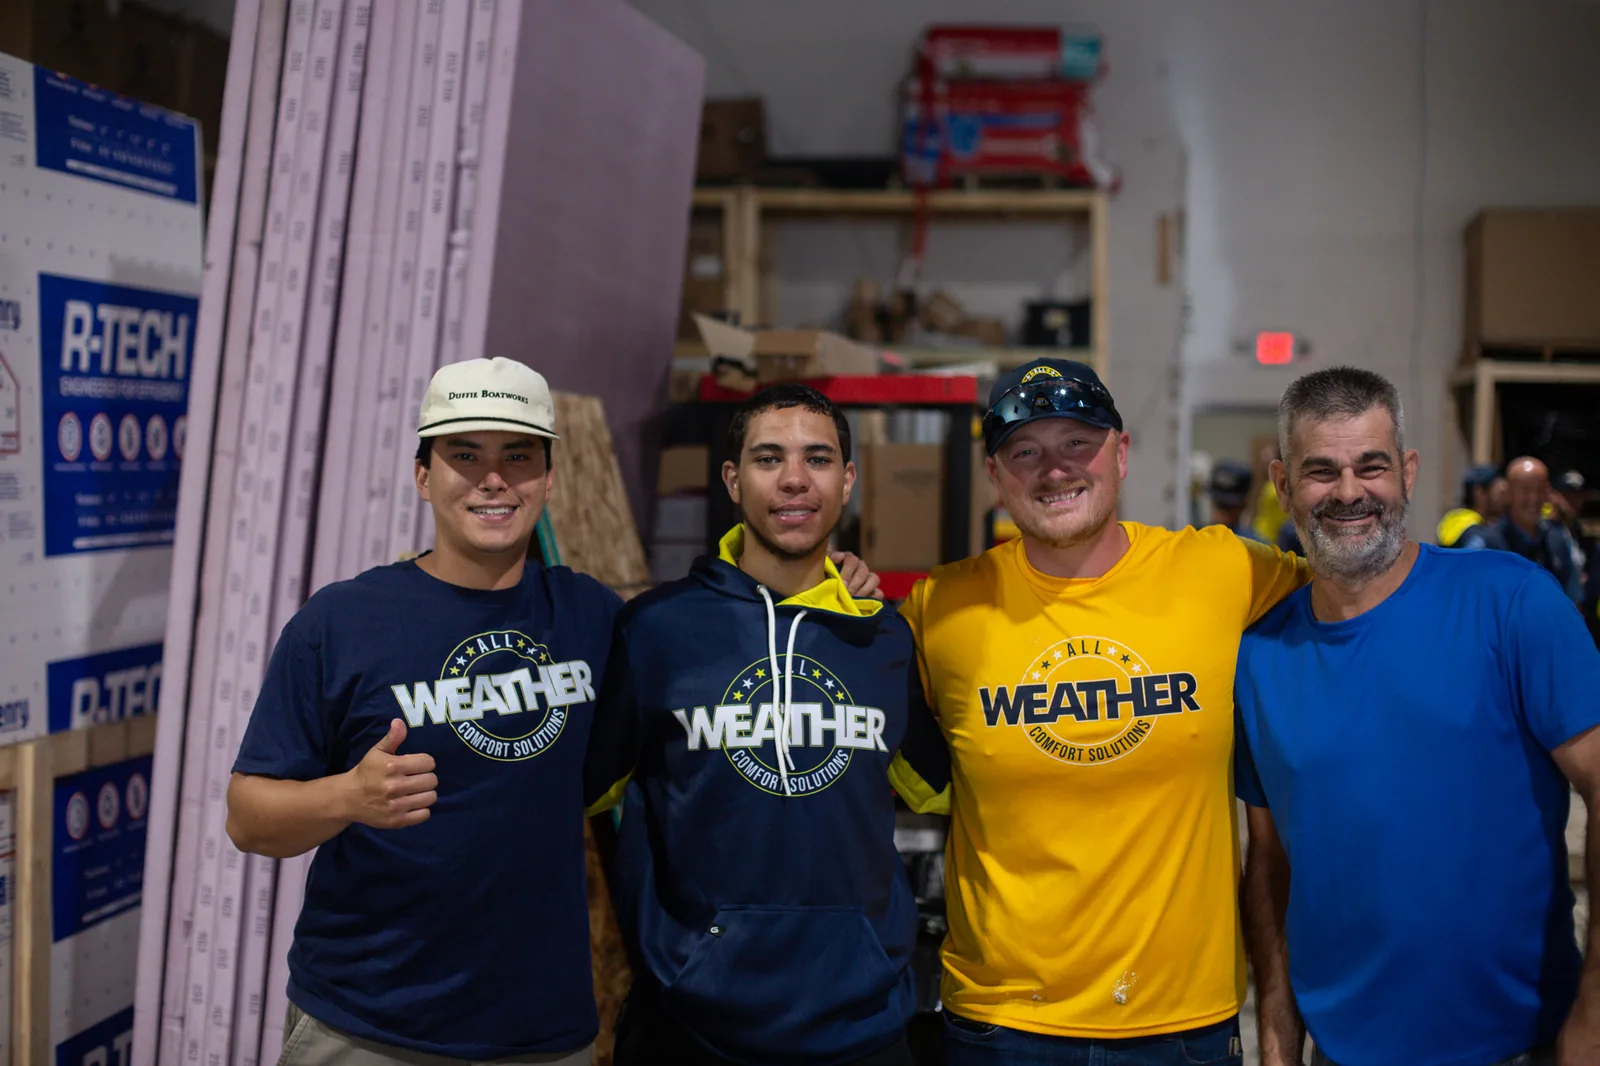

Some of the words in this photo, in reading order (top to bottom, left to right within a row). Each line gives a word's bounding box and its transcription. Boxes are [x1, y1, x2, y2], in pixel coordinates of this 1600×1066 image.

[60, 299, 190, 380] R-TECH
[448, 391, 478, 401] DUFFIE
[481, 389, 529, 405] BOATWORKS
[476, 633, 514, 654] ALL
[1066, 639, 1101, 658] ALL
[391, 659, 596, 728] WEATHER
[977, 671, 1202, 728] WEATHER
[457, 720, 511, 758] COMFORT
[512, 707, 566, 758] SOLUTIONS
[671, 702, 890, 753] WEATHER
[1029, 725, 1085, 762] COMFORT
[1088, 719, 1152, 763] SOLUTIONS
[790, 748, 850, 793] SOLUTIONS
